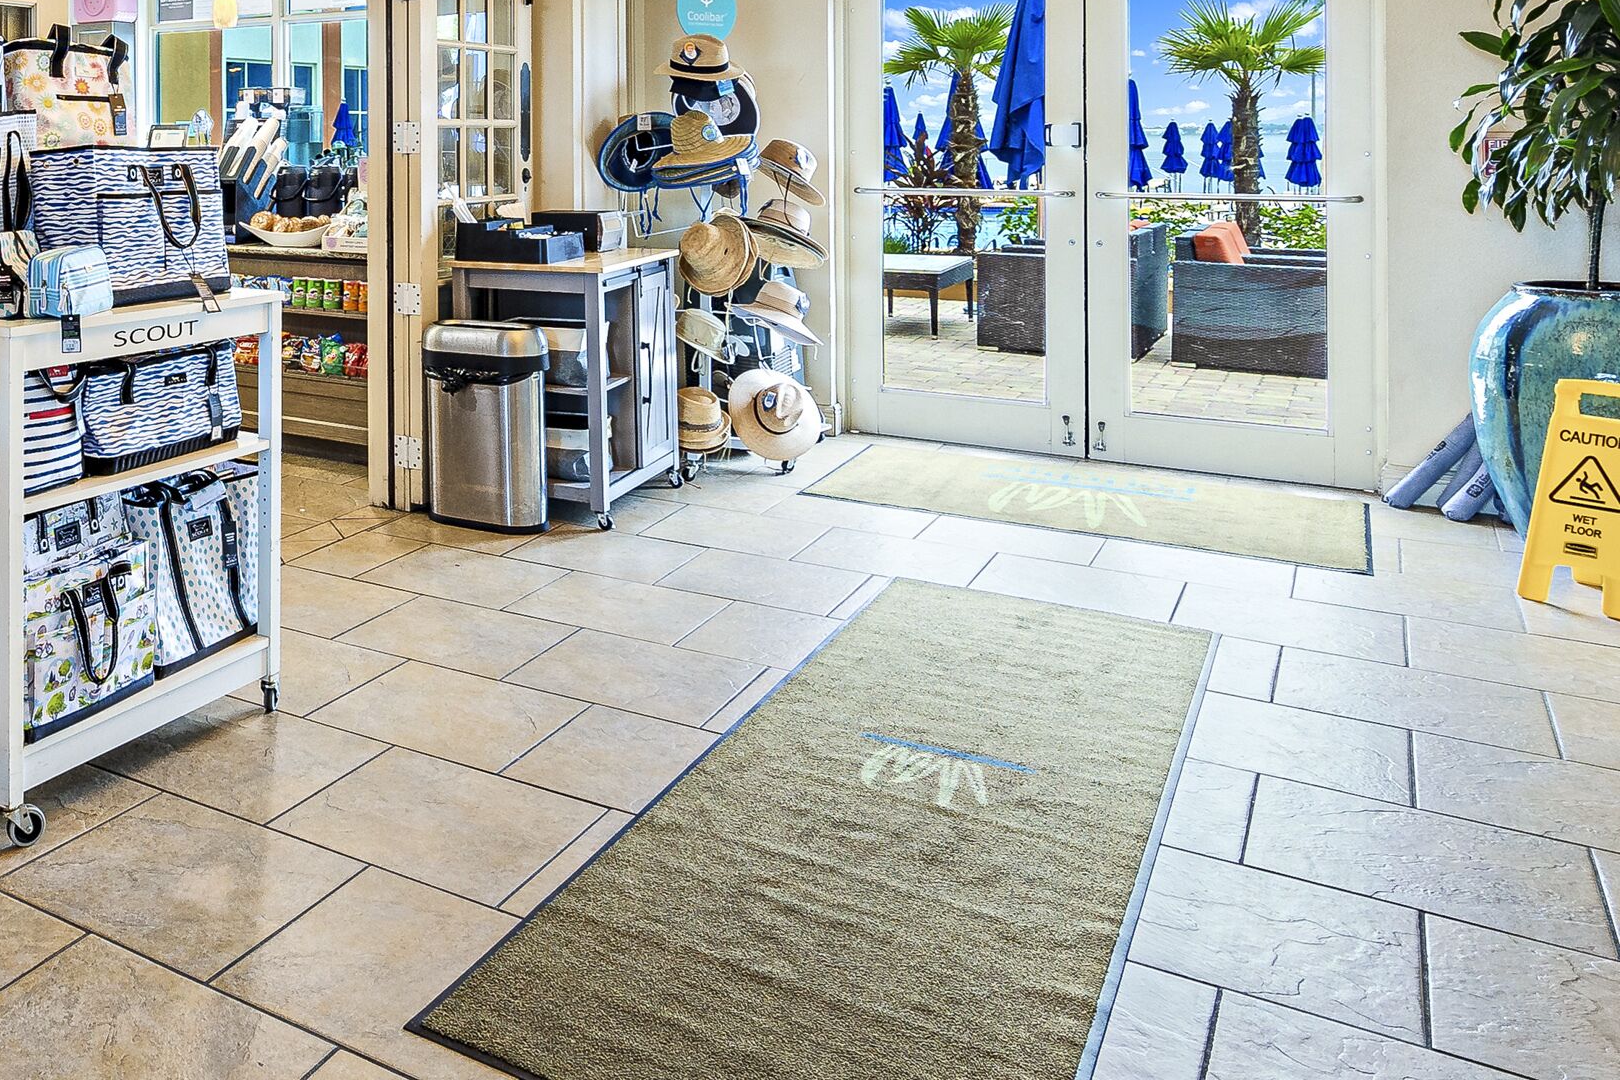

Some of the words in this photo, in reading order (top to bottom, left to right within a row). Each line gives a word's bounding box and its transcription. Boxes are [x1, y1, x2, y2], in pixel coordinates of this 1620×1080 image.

[687, 10, 725, 22] Coolibar
[113, 319, 199, 348] SCOUT
[1559, 429, 1620, 449] CAUTIO
[1572, 513, 1598, 526] WET
[1564, 524, 1602, 539] FLOOR
